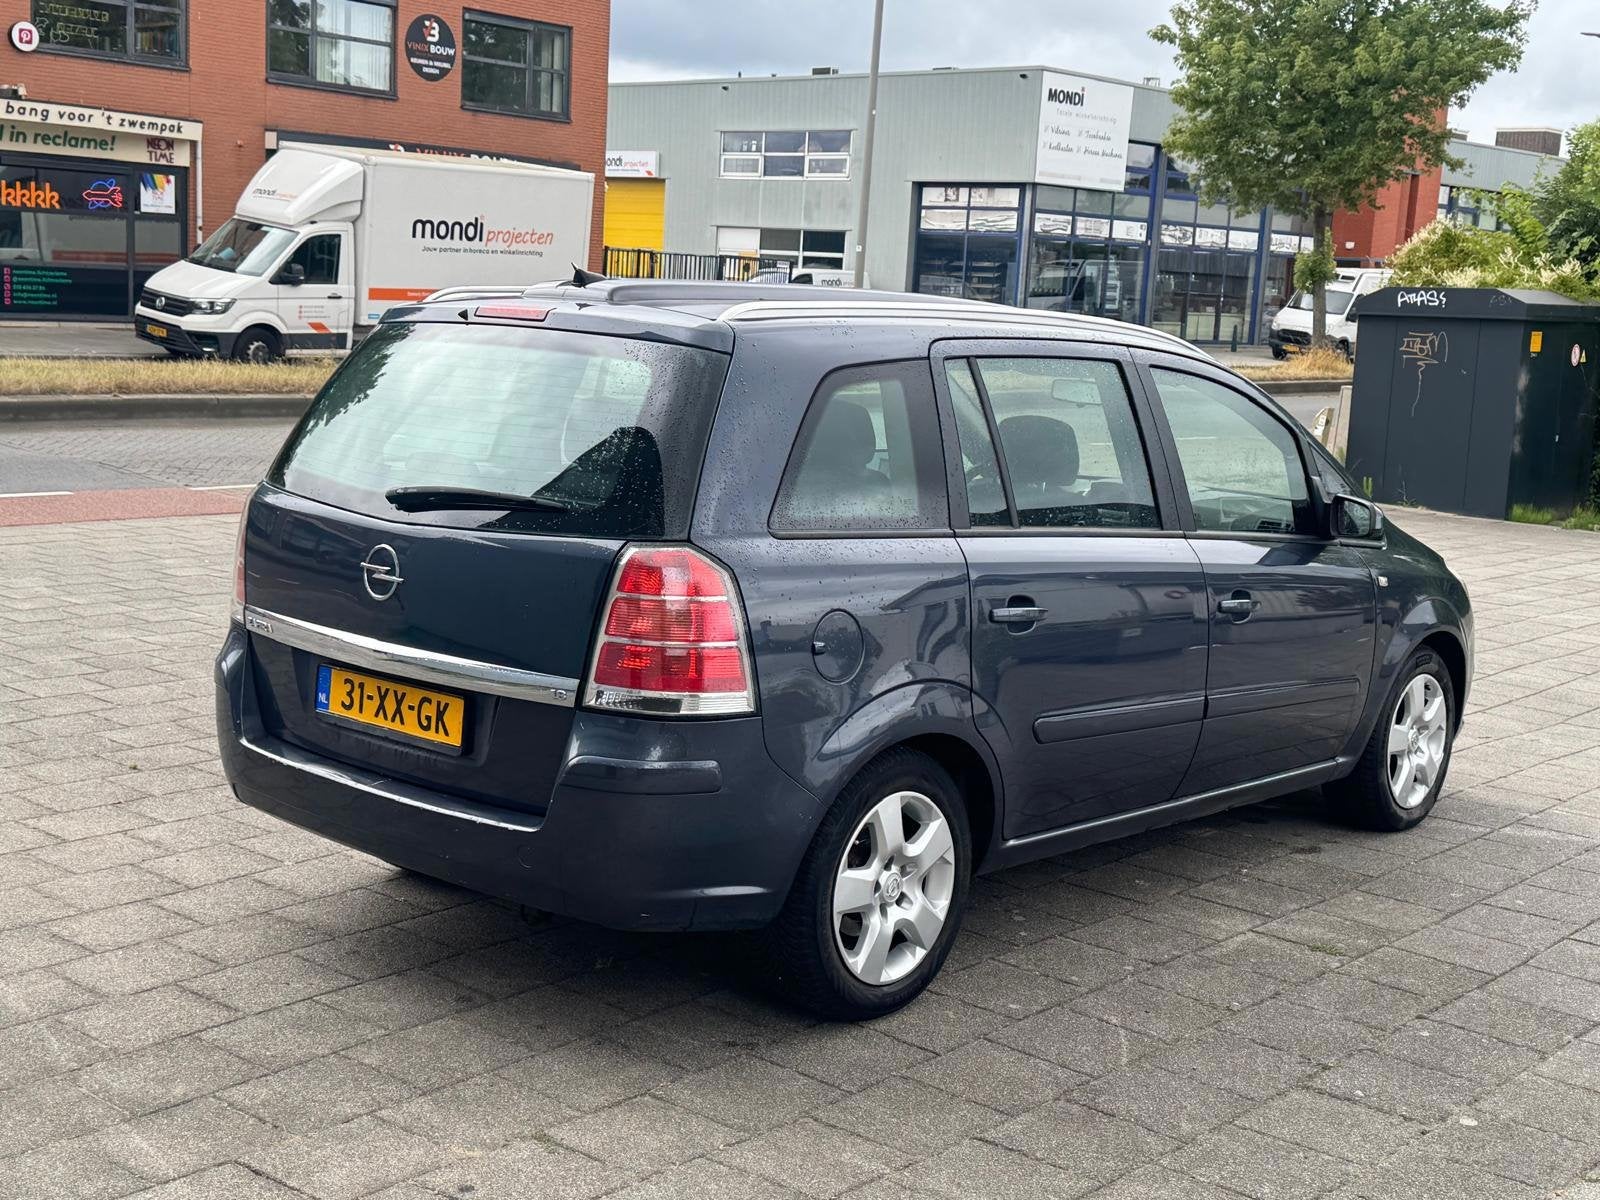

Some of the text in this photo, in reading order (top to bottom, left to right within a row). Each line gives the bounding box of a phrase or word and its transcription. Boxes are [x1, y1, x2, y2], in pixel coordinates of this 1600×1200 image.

[430, 44, 455, 56] BOUW
[5, 101, 183, 134] bang voor 't zwempak
[9, 126, 27, 143] in
[34, 131, 116, 151] reclame!
[147, 150, 175, 164] TIME
[411, 214, 554, 248] mondi projecten
[318, 692, 328, 704] NL
[341, 678, 449, 737] 31-XX-GK
